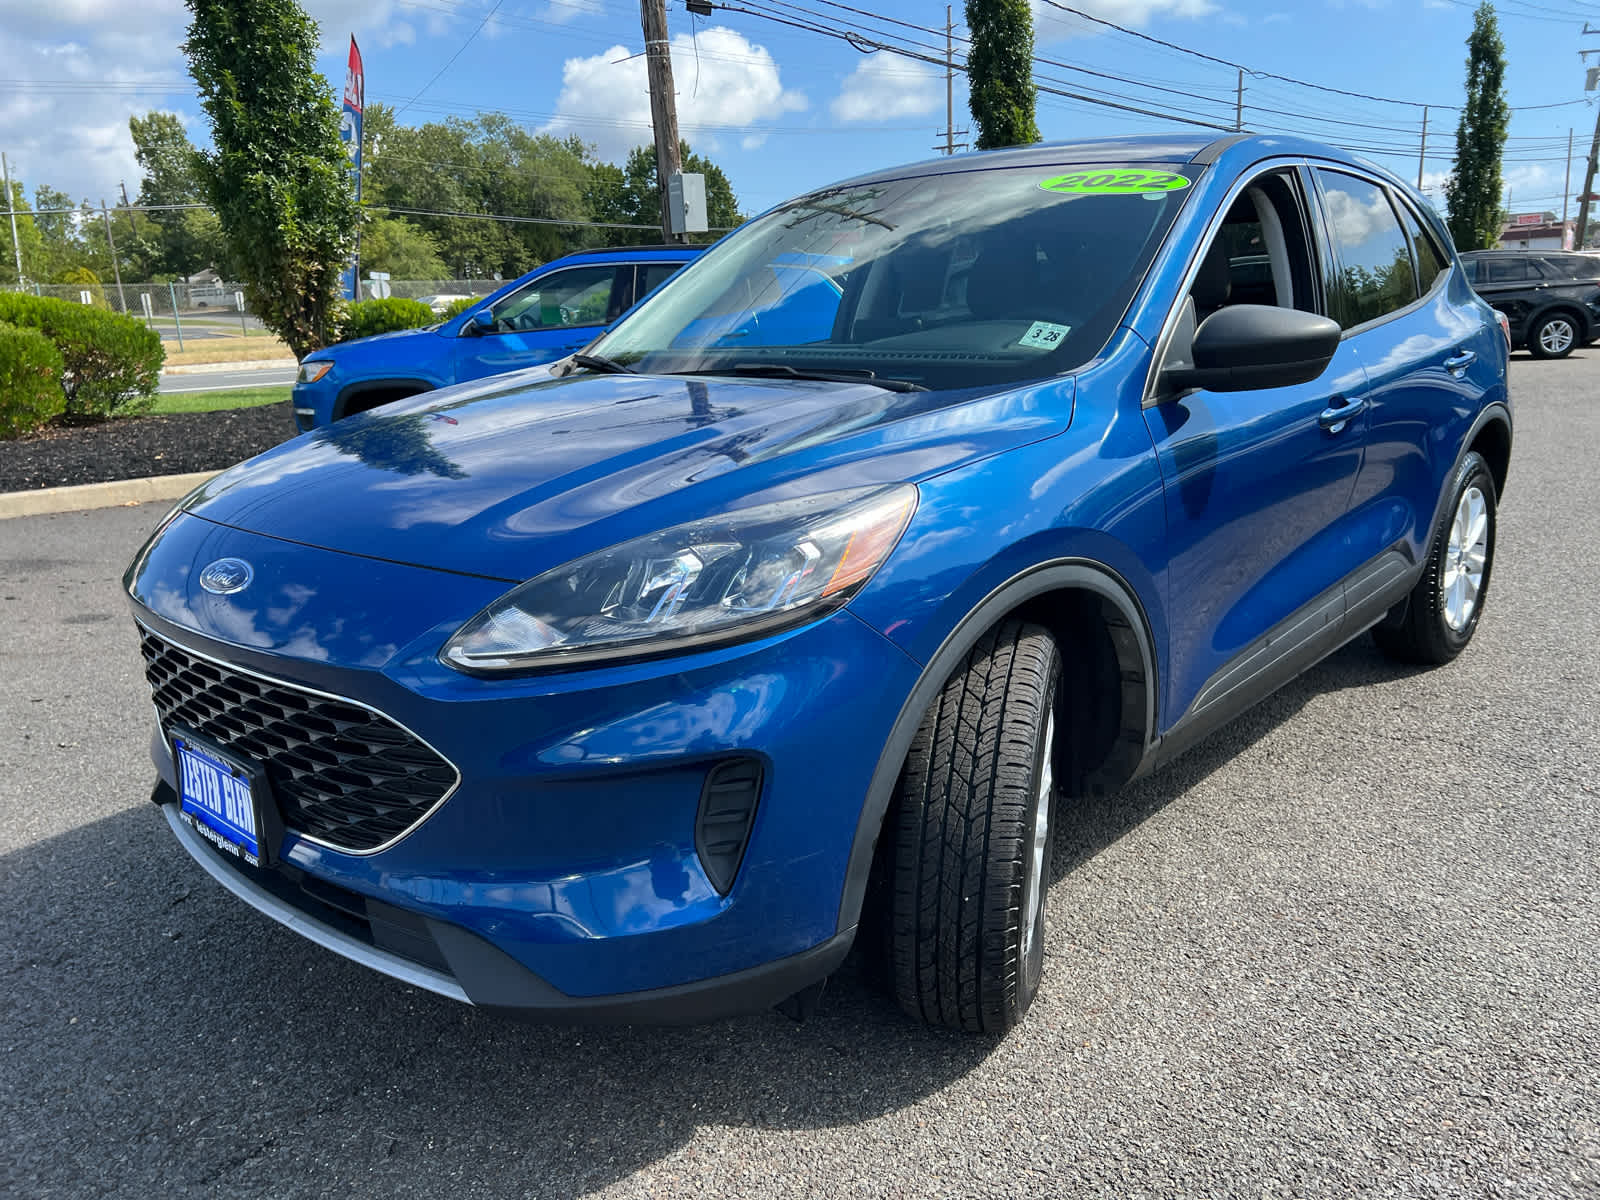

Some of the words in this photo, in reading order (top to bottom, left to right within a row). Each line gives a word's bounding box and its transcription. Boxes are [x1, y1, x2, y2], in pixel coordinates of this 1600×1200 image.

[1051, 174, 1178, 188] 2022
[1032, 328, 1042, 339] 3
[1043, 330, 1060, 342] 28
[206, 562, 239, 585] Ford
[180, 751, 222, 815] LESTER
